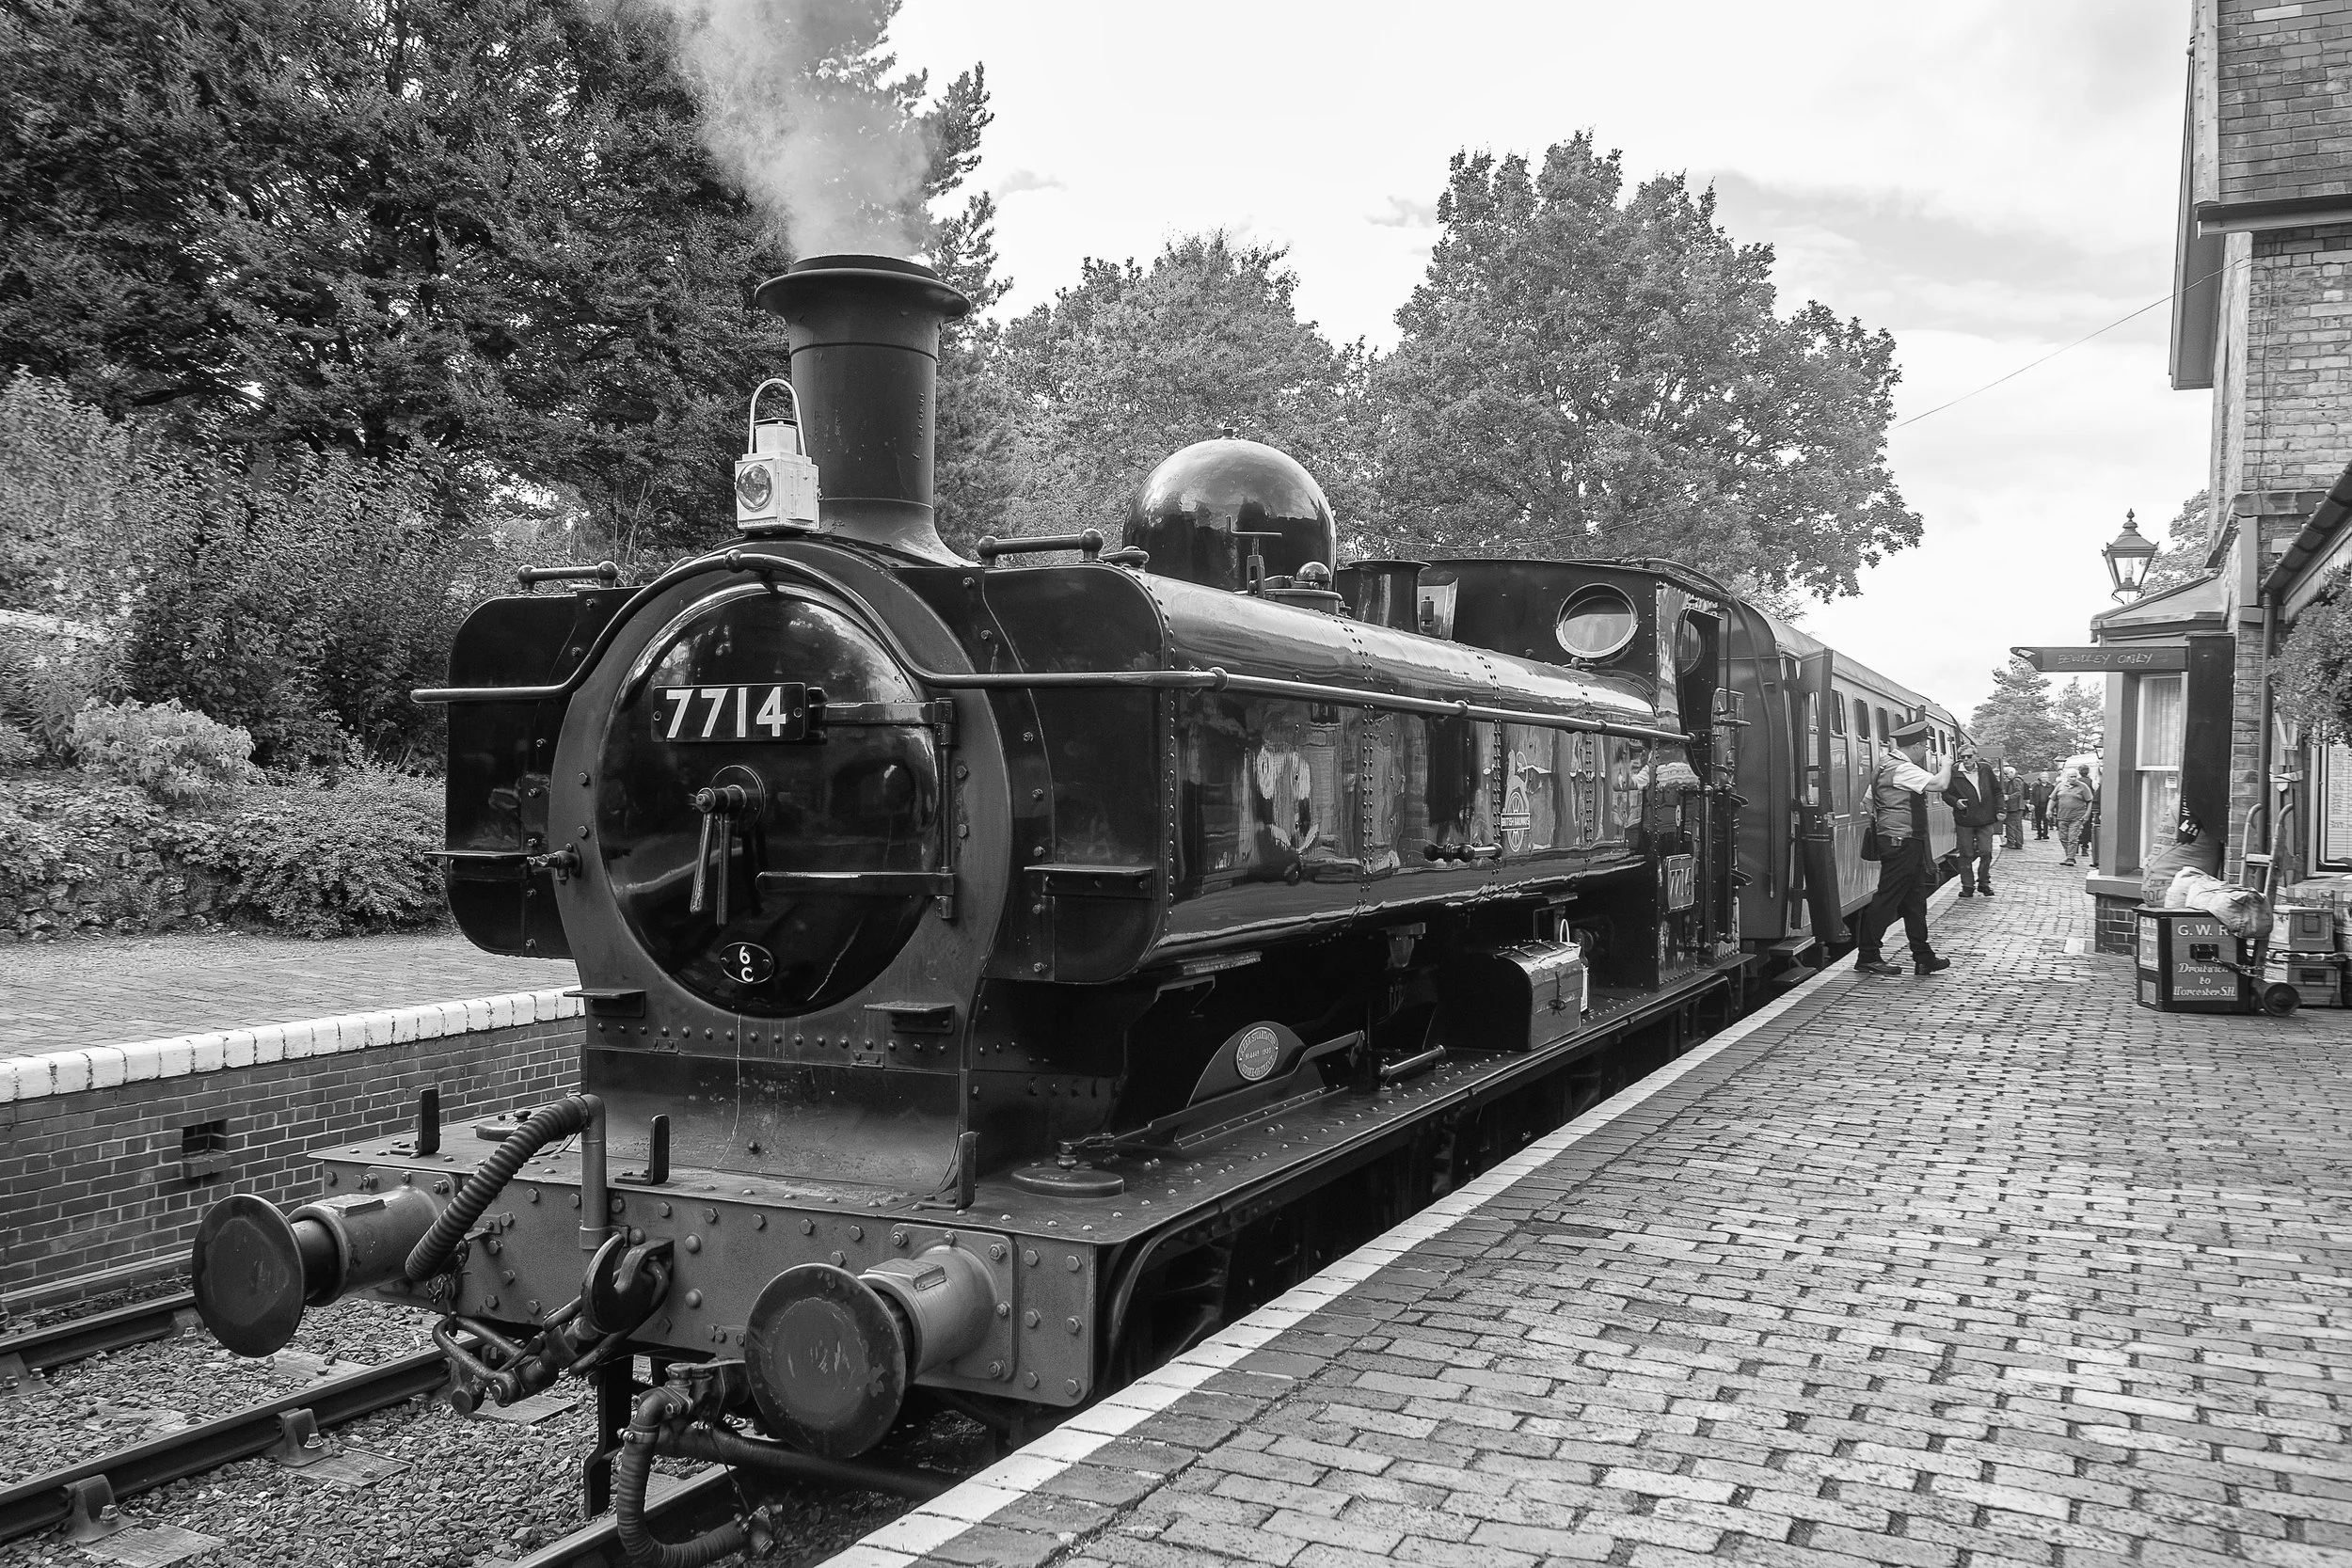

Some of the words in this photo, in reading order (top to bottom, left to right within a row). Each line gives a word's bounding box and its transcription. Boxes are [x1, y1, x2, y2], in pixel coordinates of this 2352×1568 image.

[2058, 653, 2111, 665] BEWDLEY
[2117, 653, 2153, 664] ONLY
[665, 686, 787, 739] 7714
[1669, 867, 1692, 897] 7714
[739, 945, 751, 964] 6
[740, 966, 755, 983] C
[2199, 976, 2211, 985] to
[2173, 986, 2219, 996] Worcester
